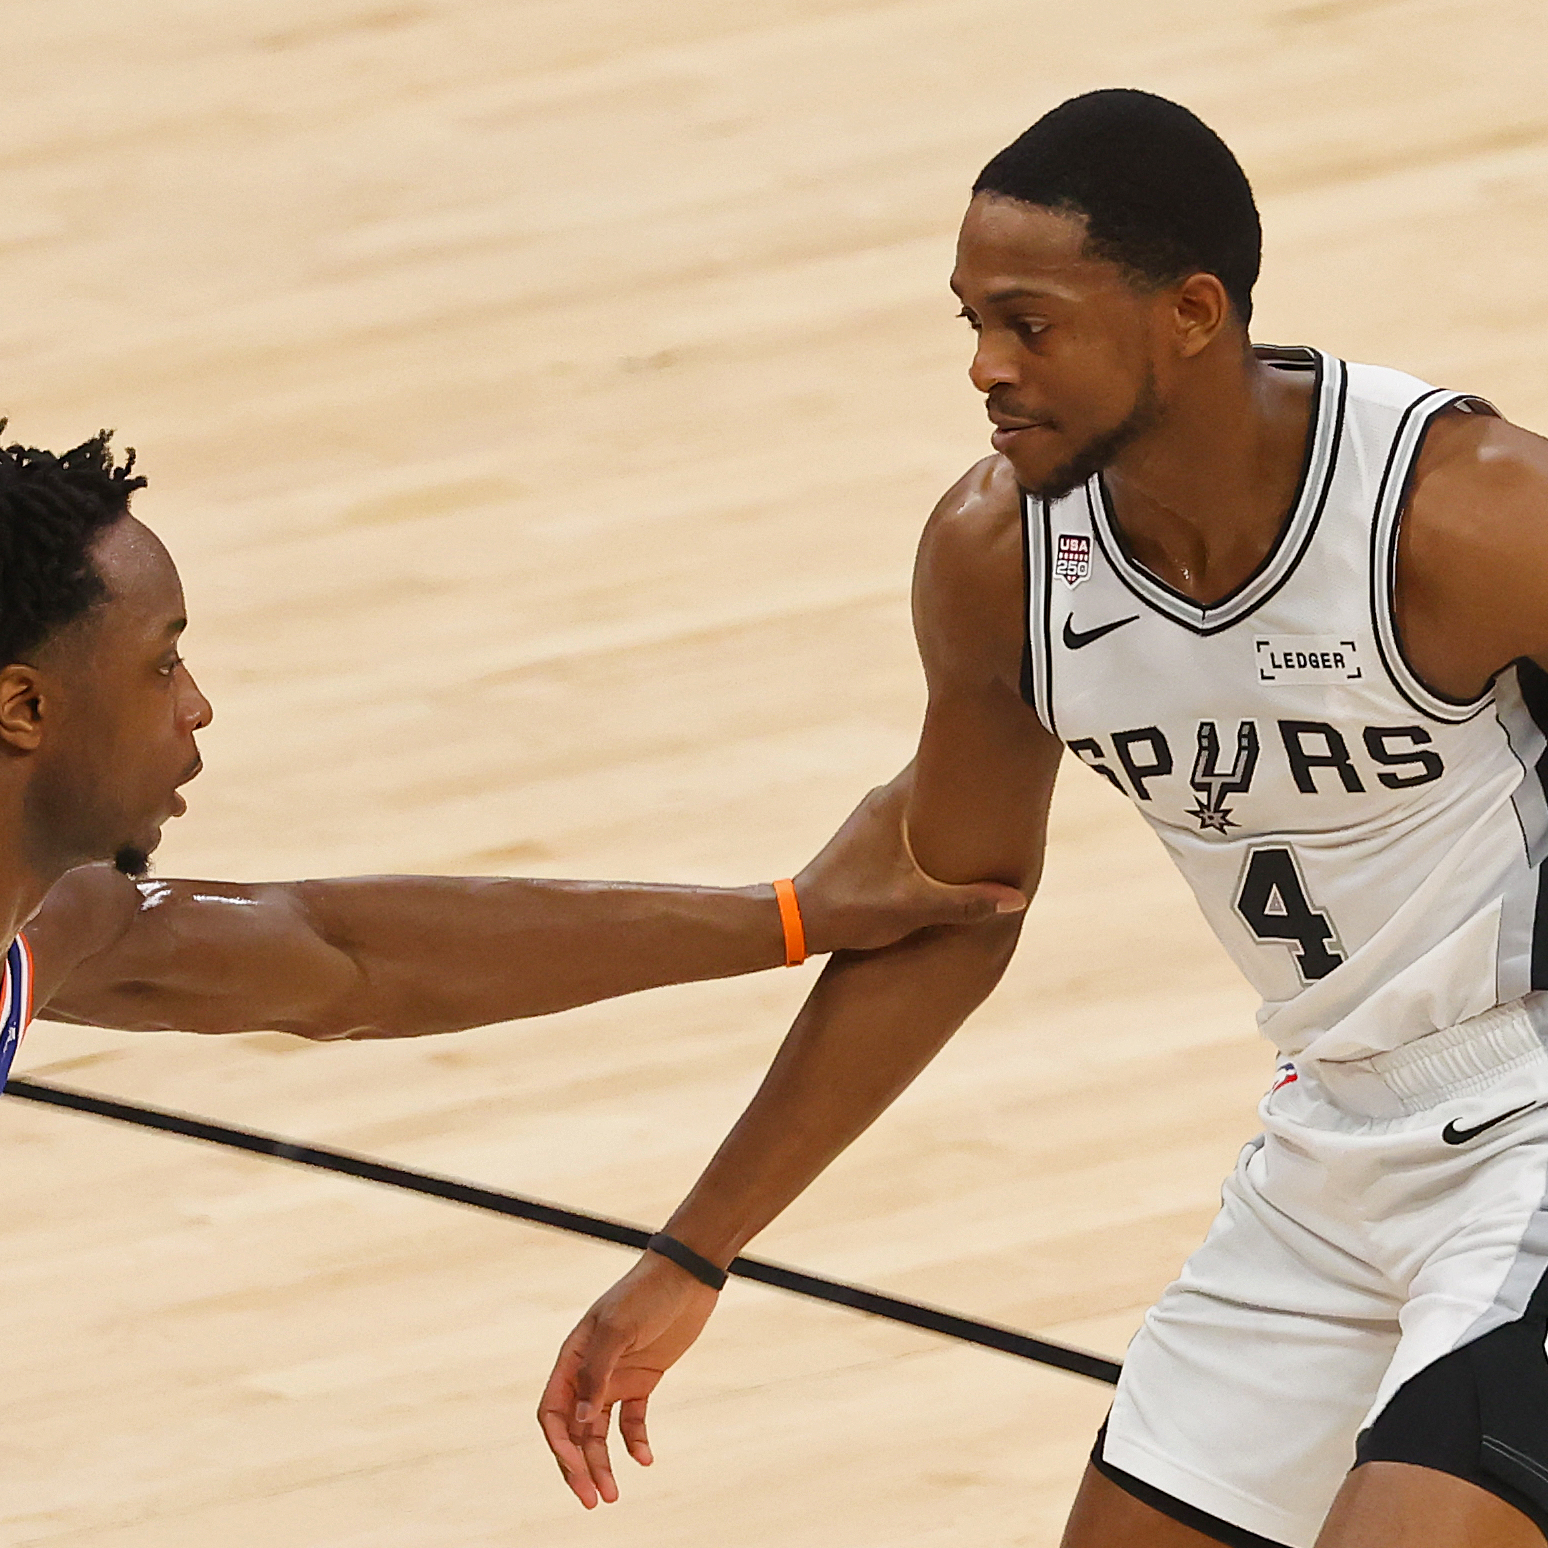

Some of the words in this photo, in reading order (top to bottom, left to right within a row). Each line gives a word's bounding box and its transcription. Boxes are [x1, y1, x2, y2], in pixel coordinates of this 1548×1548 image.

[1060, 537, 1088, 552] USA
[1056, 559, 1088, 576] 250
[1269, 651, 1346, 669] LEDGER
[1232, 843, 1349, 988] 4
